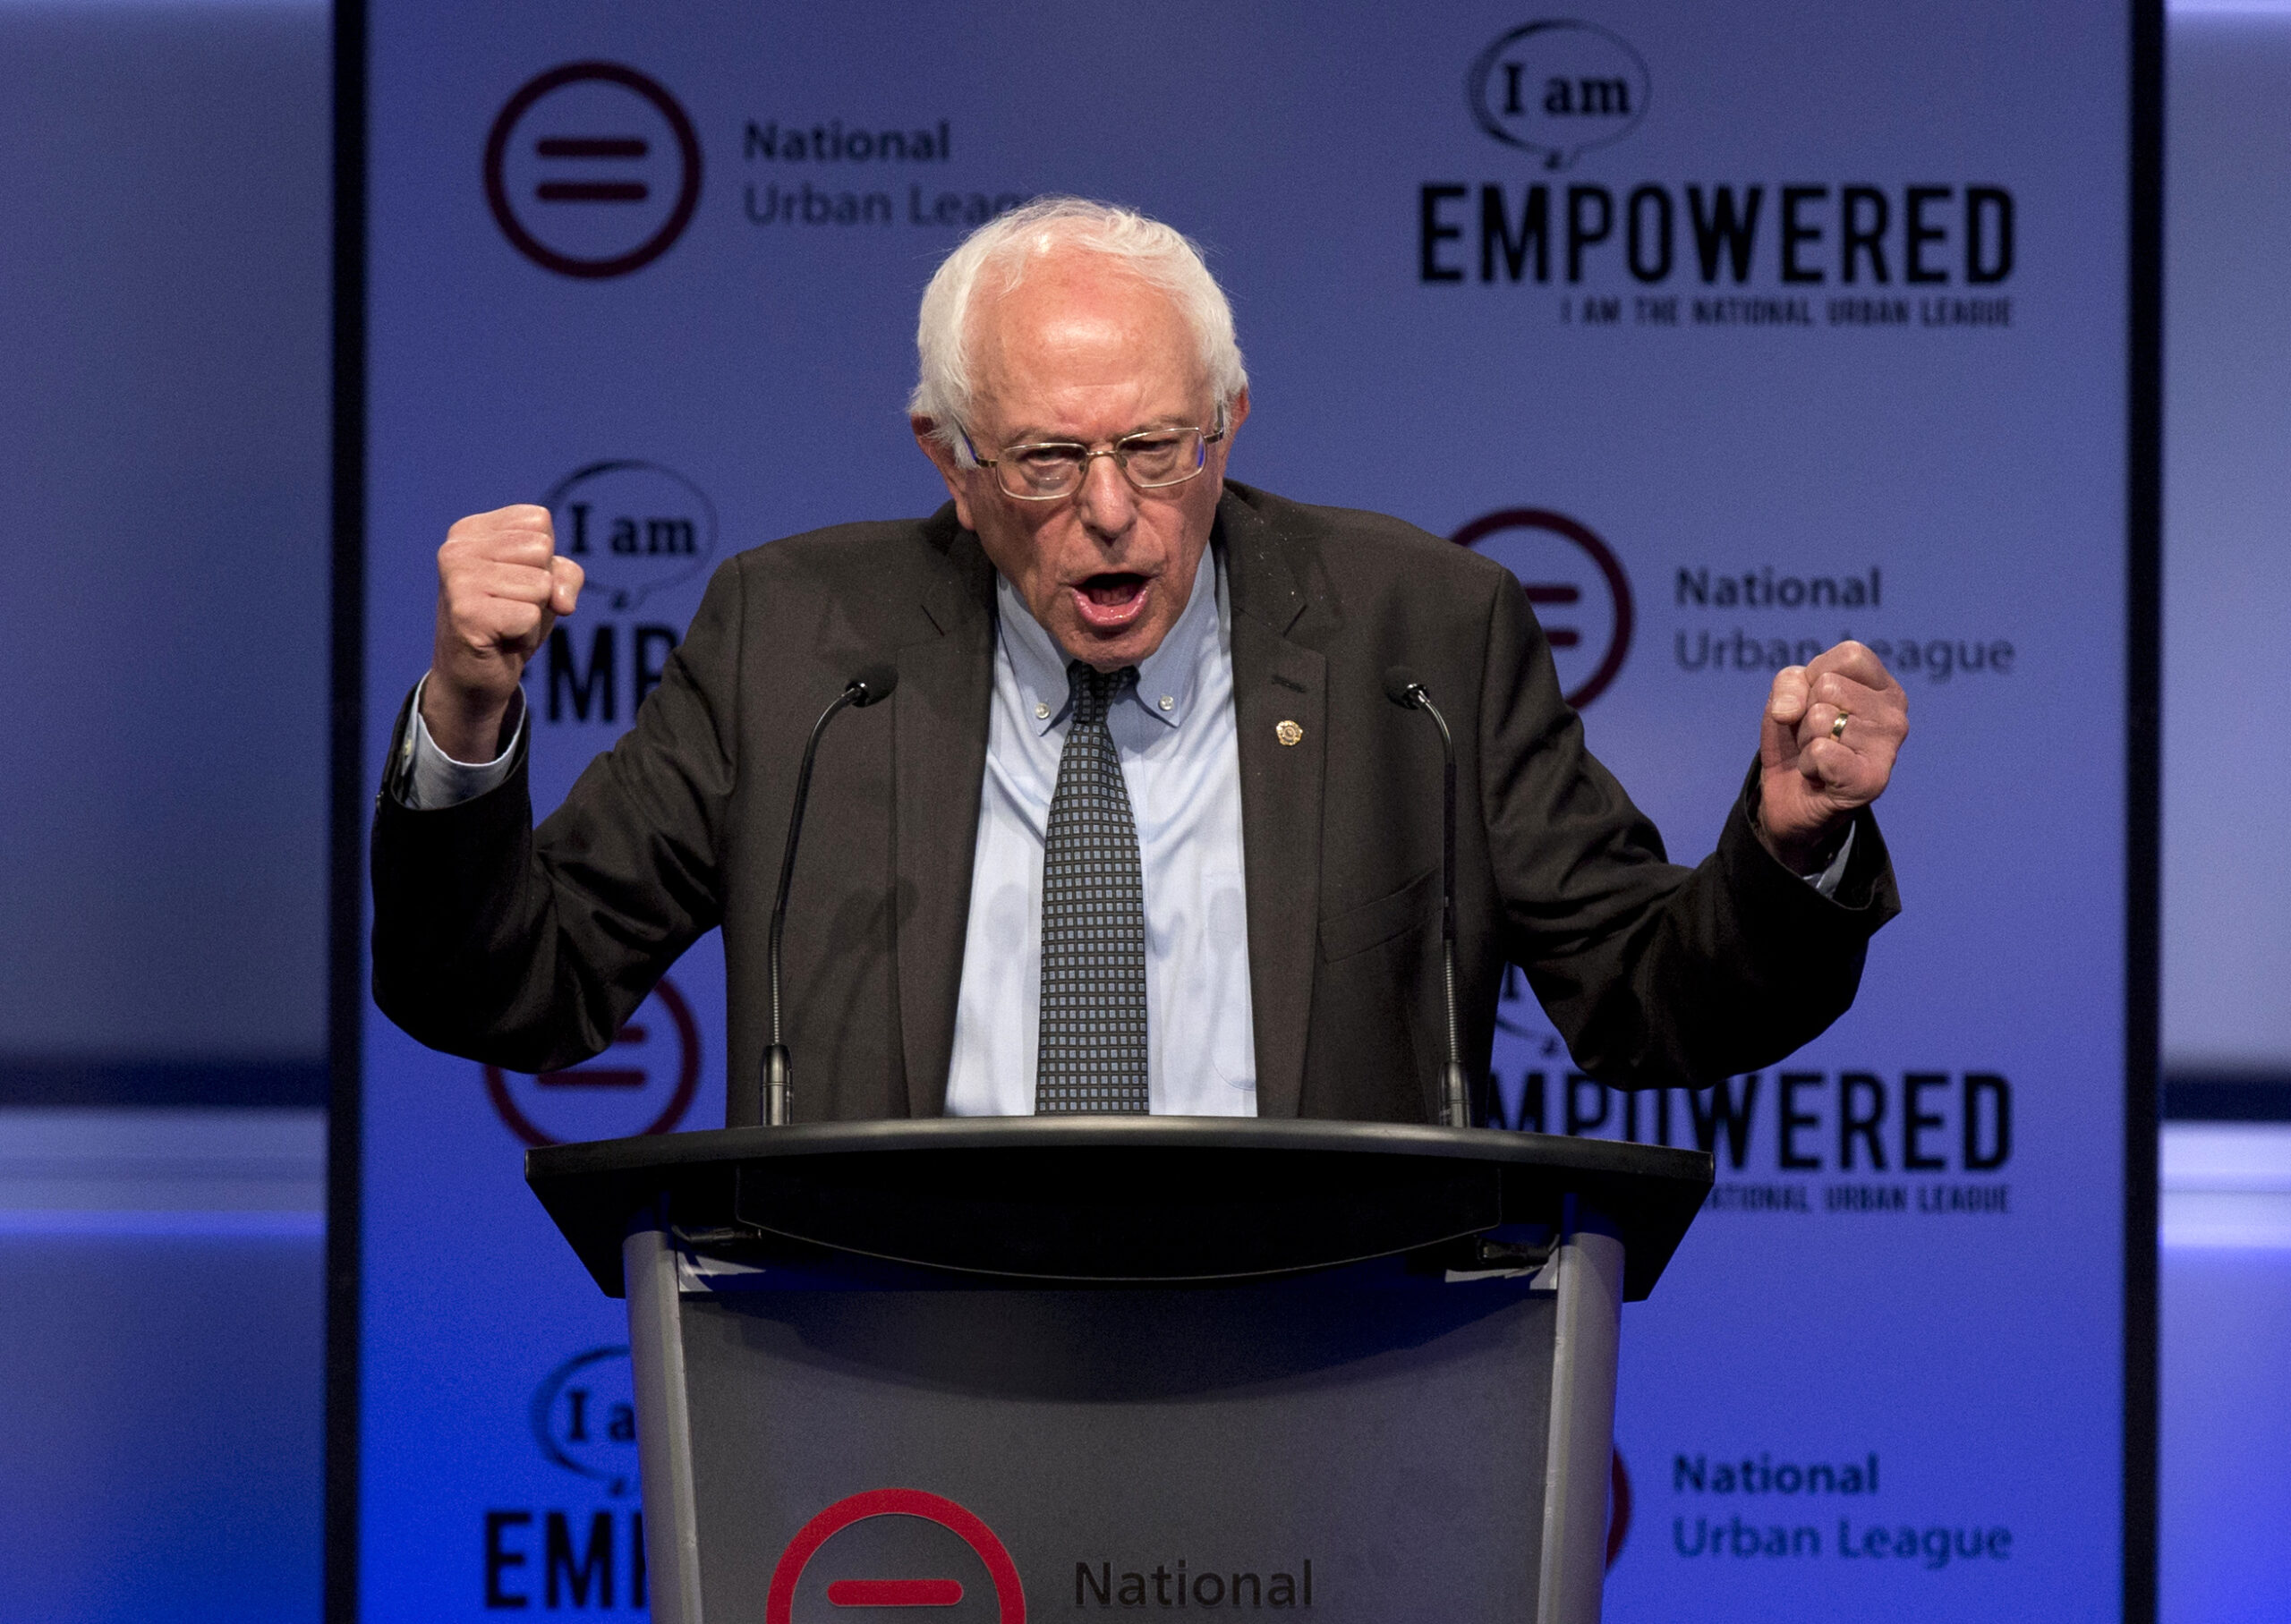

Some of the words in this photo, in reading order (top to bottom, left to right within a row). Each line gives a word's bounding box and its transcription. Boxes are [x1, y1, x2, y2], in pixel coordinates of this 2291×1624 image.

[1502, 62, 1525, 116] I
[1542, 76, 1631, 116] am
[744, 119, 950, 163] National
[744, 184, 893, 226] Urban
[1420, 184, 2016, 285] EMPOWERED
[571, 502, 592, 555] I
[609, 517, 696, 557] am
[1674, 566, 1882, 609] National
[1674, 630, 1823, 673] Urban
[1841, 630, 2015, 684] eague
[568, 1390, 587, 1441] I
[609, 1402, 636, 1443] a
[1673, 1451, 1878, 1495] National
[1673, 1518, 1822, 1559] Urban
[1838, 1518, 2013, 1570] League
[1076, 1559, 1313, 1607] National
